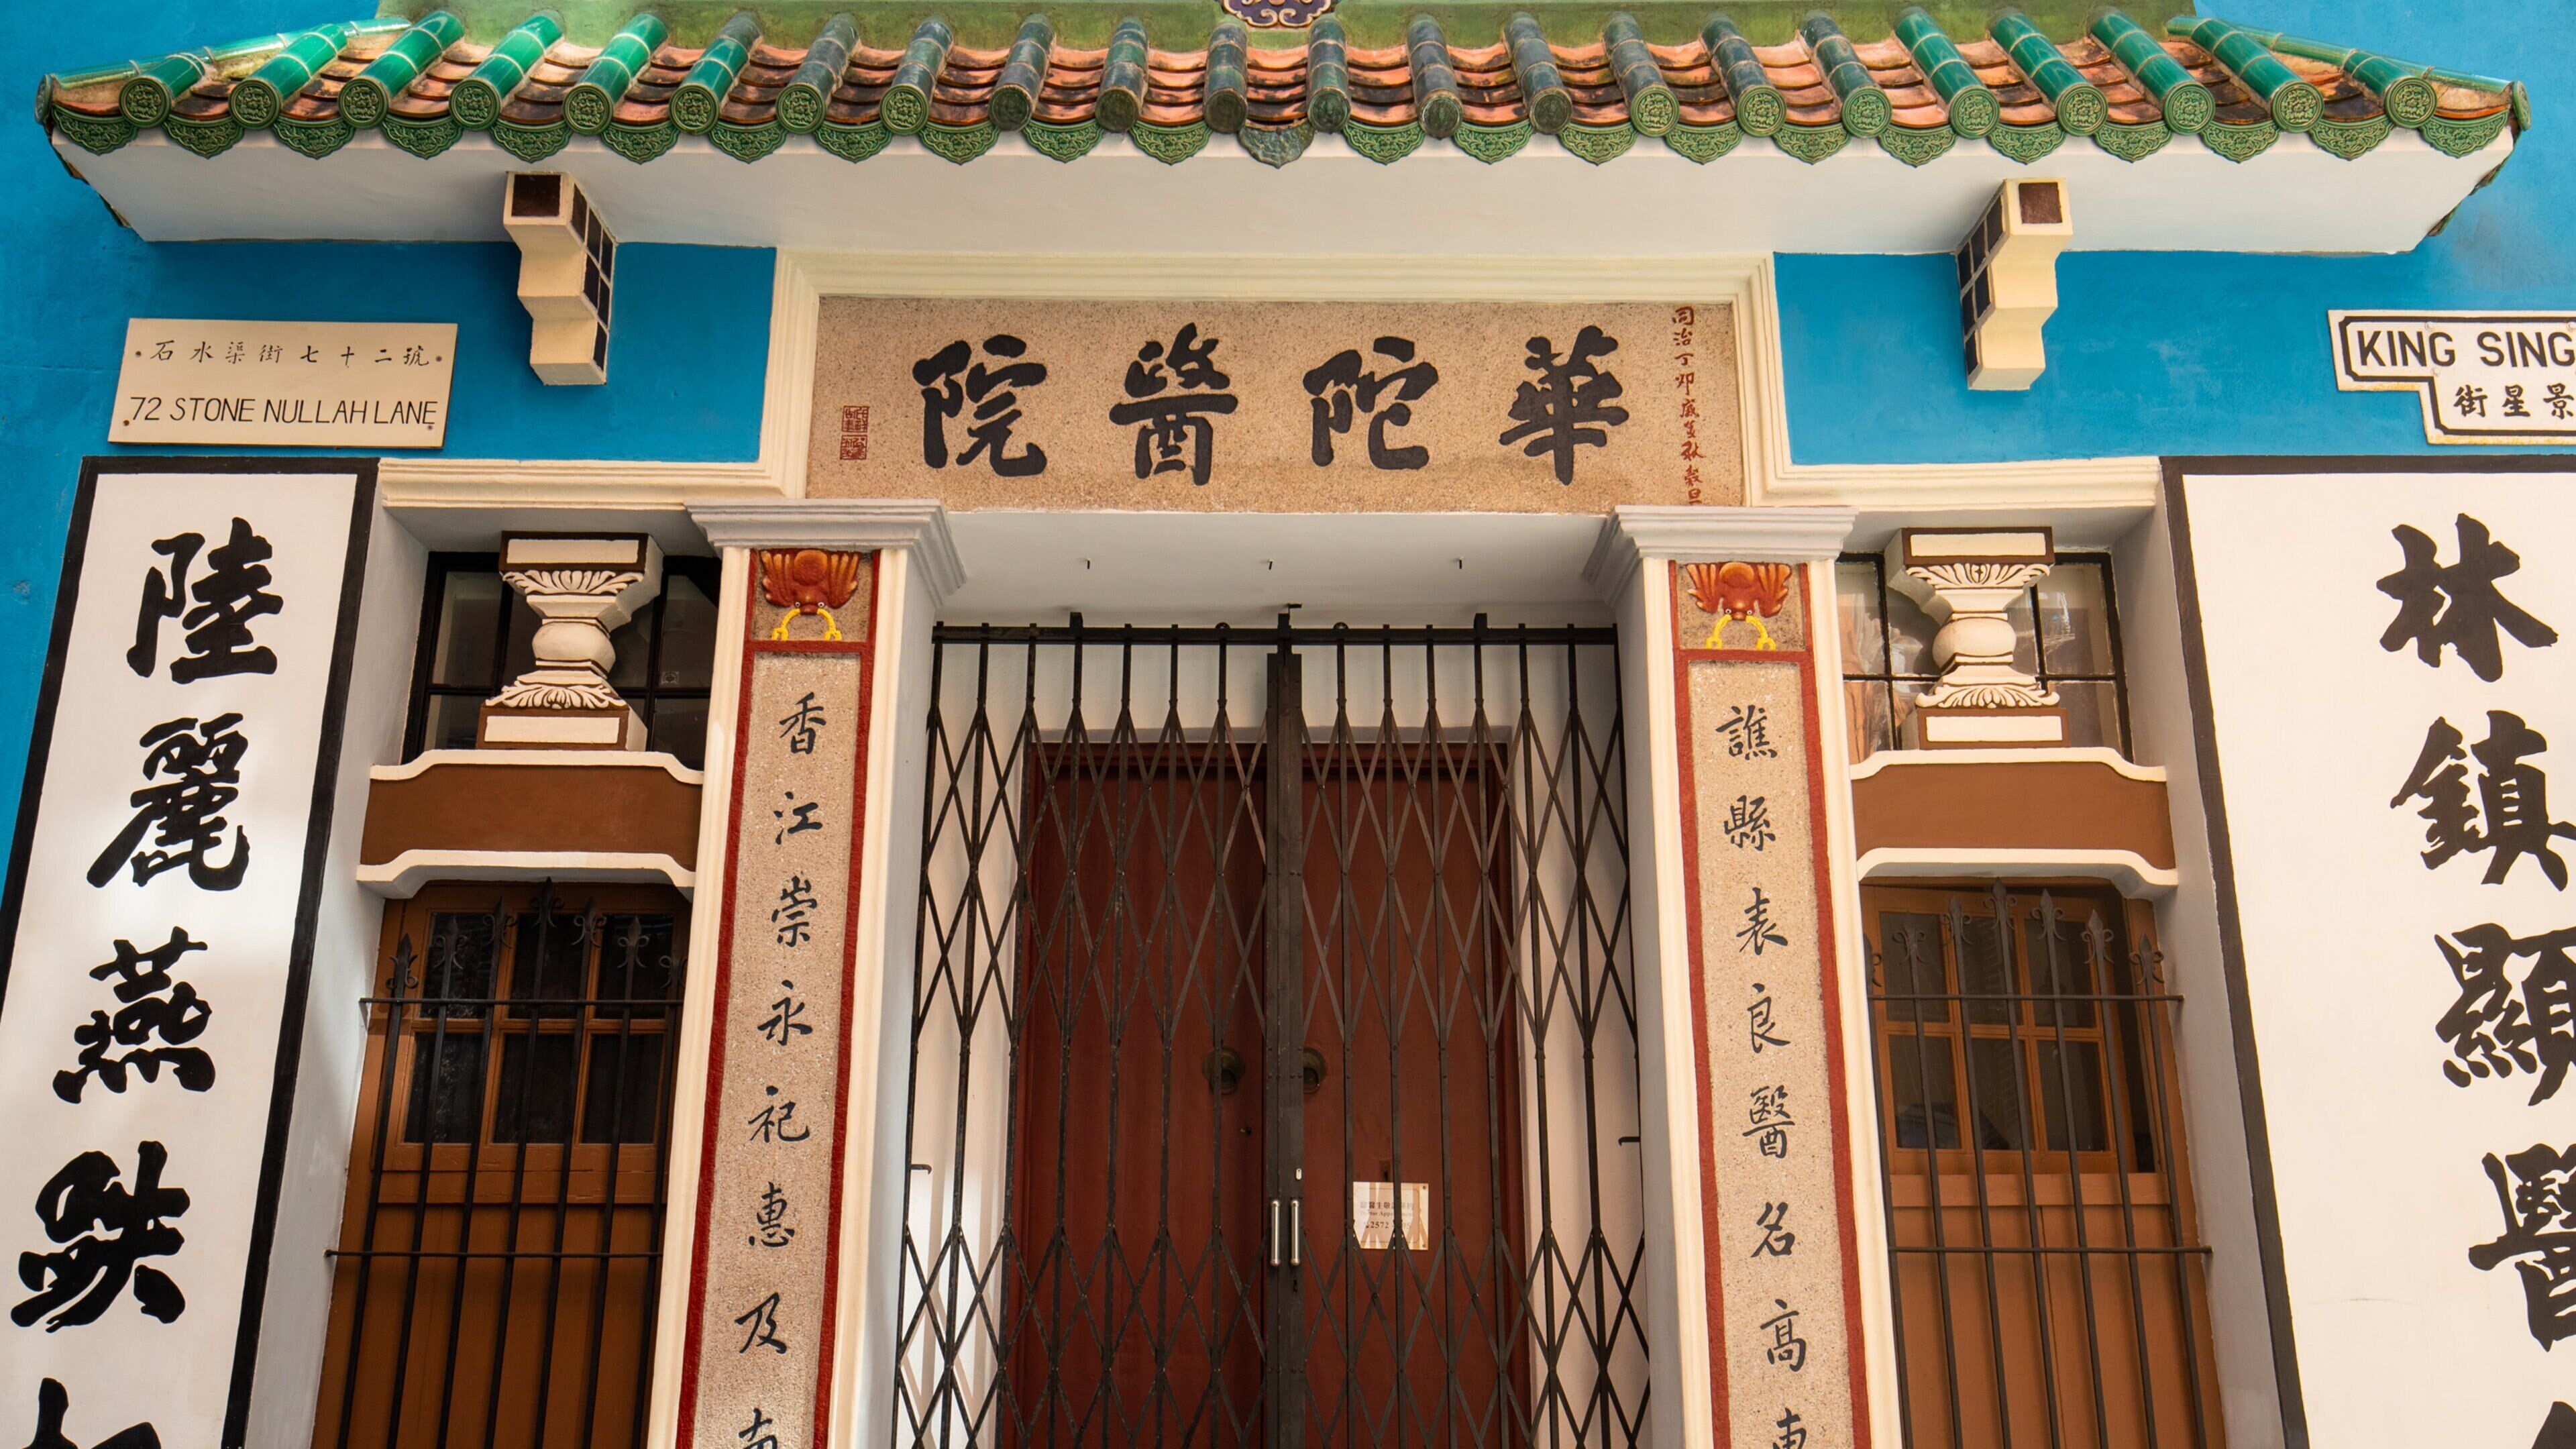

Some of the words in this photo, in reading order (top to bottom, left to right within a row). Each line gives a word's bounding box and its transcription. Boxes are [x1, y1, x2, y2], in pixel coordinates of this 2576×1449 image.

[150, 340, 430, 367] 石水渠街七十二號
[2357, 330, 2456, 367] KING
[2477, 331, 2575, 368] SING
[130, 397, 162, 421] 72
[170, 397, 256, 422] STONE
[264, 399, 368, 424] NULLAH
[374, 400, 438, 425] LANE
[912, 322, 1629, 486] 華陀醫院
[2376, 513, 2576, 1449] 林鎮顯醫
